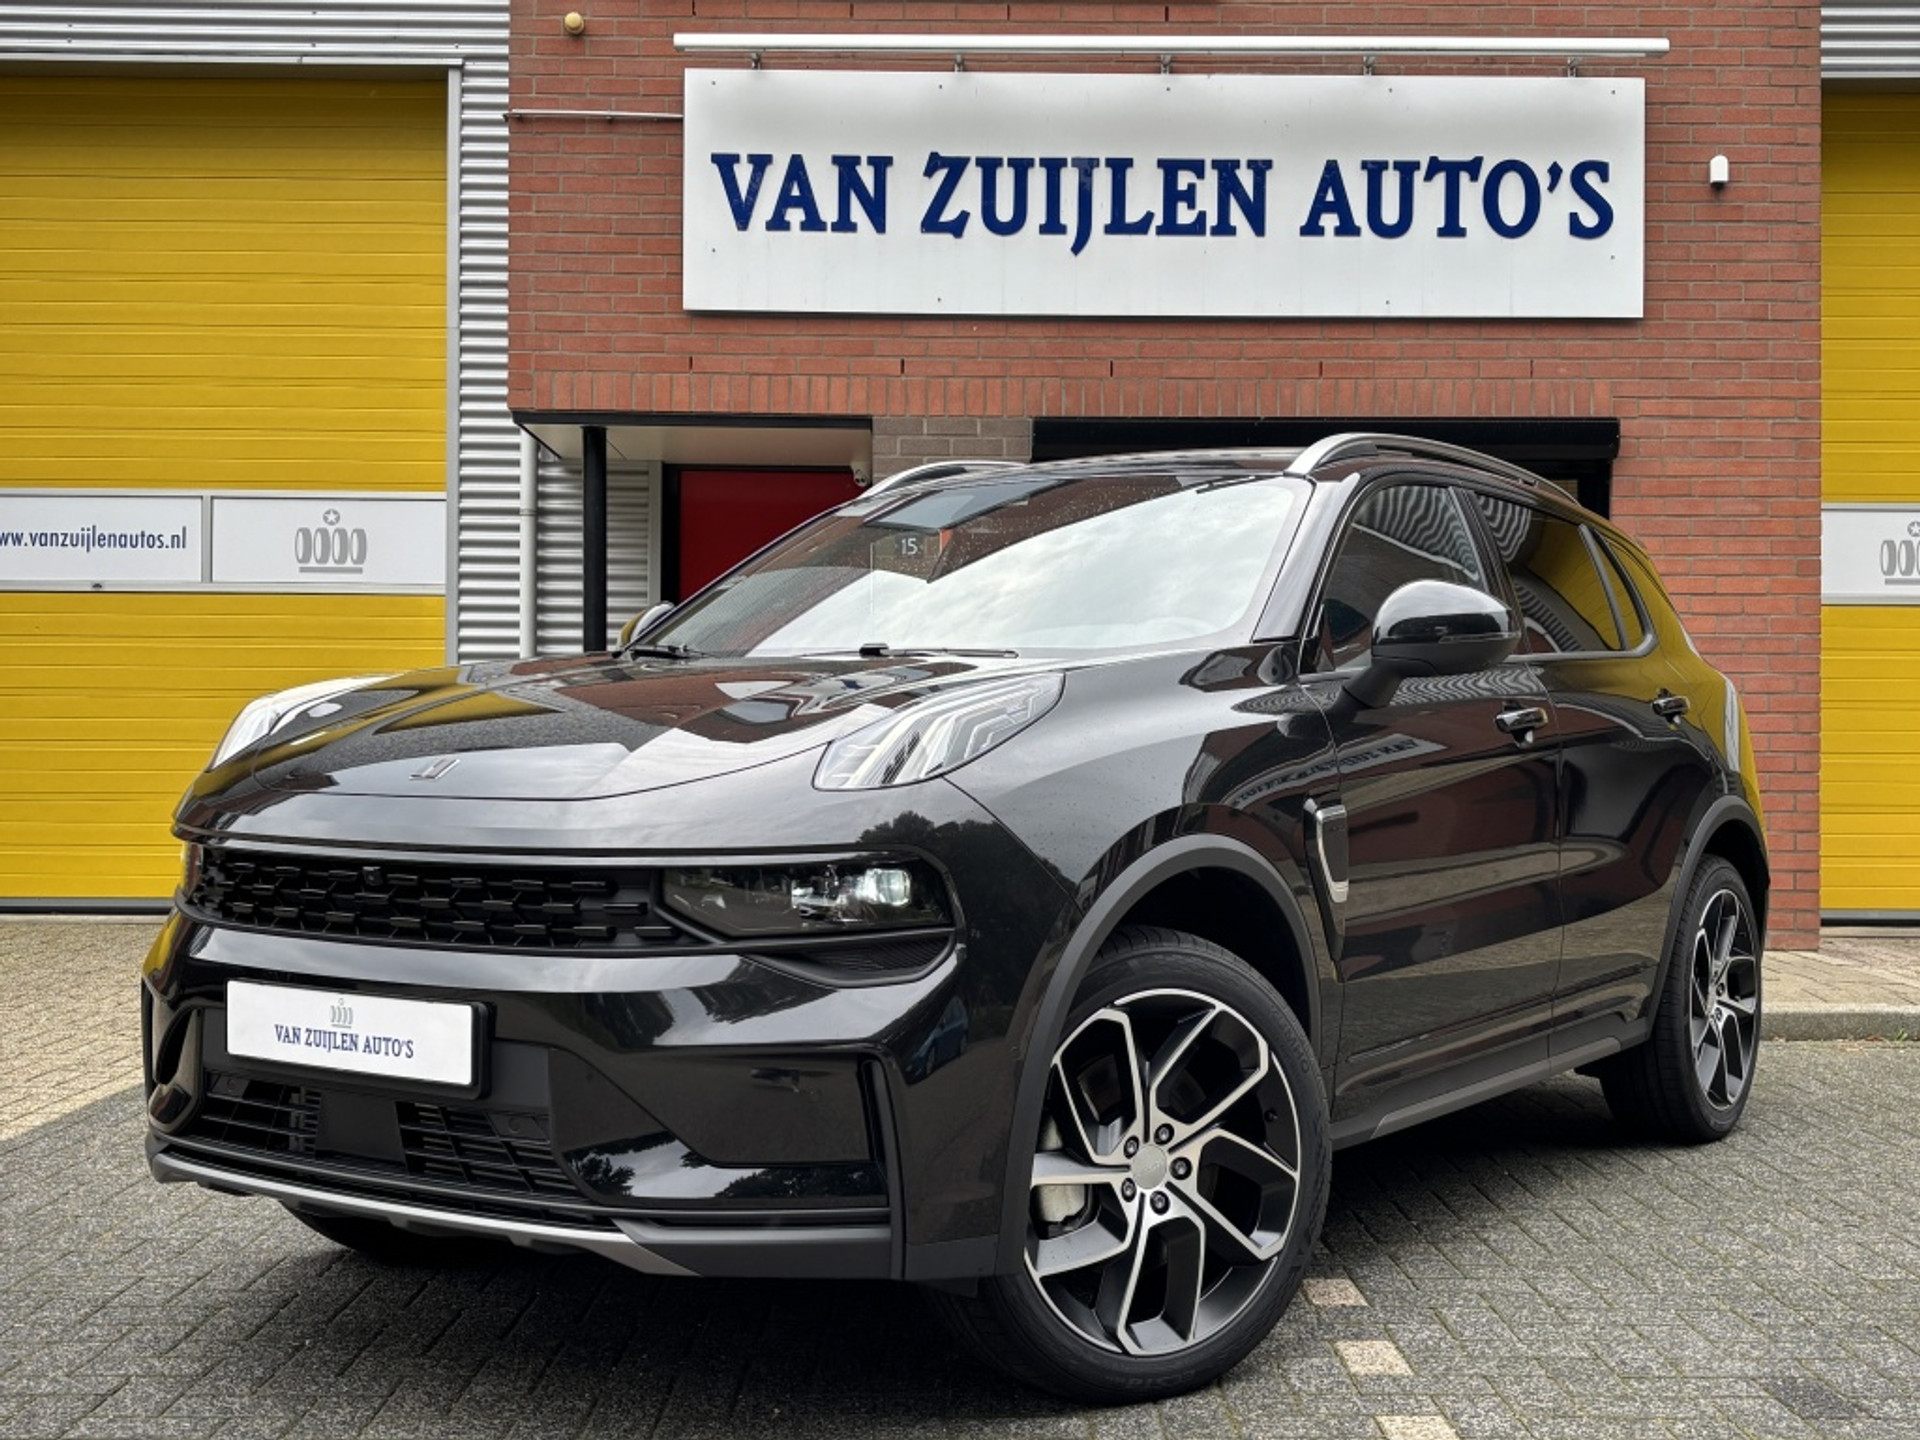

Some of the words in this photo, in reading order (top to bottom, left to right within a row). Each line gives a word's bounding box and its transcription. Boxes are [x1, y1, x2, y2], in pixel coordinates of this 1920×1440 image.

[711, 153, 893, 233] VAN
[921, 151, 1273, 256] ZUIJLEN
[1299, 156, 1614, 239] AUTO'S
[902, 538, 918, 555] 15
[275, 1024, 301, 1044] VAN
[304, 1028, 359, 1052] ZUIJLEN
[362, 1036, 414, 1059] AUTO'S
